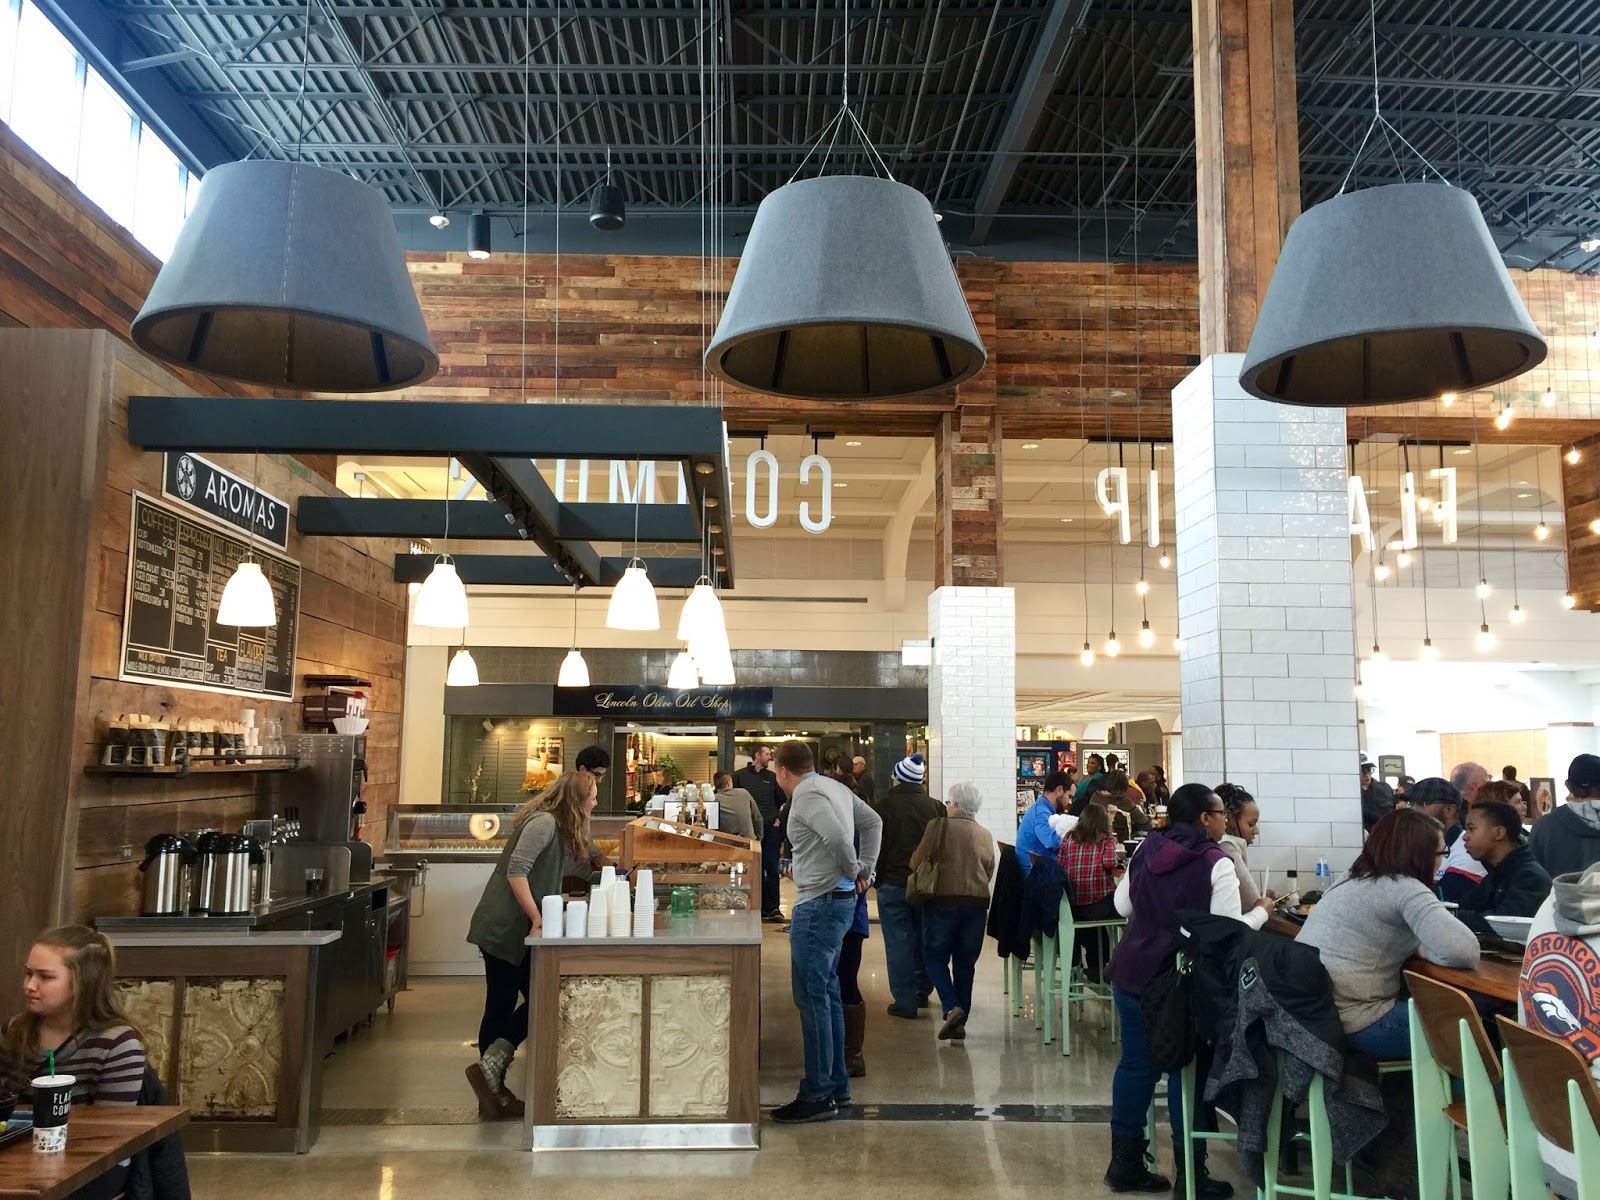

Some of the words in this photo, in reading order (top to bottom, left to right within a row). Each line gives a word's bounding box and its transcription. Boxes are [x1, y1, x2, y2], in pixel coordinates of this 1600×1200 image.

[205, 471, 275, 530] AROMAS
[141, 507, 174, 536] COFFEE
[138, 528, 147, 539] CUP
[179, 523, 210, 550] ESPRESSO
[215, 647, 227, 662] TEA
[240, 641, 263, 660] FLAVORS
[594, 692, 638, 708] Lincoln
[642, 692, 673, 708] Olive
[675, 692, 700, 708] Oil
[700, 695, 731, 712] Shop
[1530, 936, 1600, 988] BRONCOS
